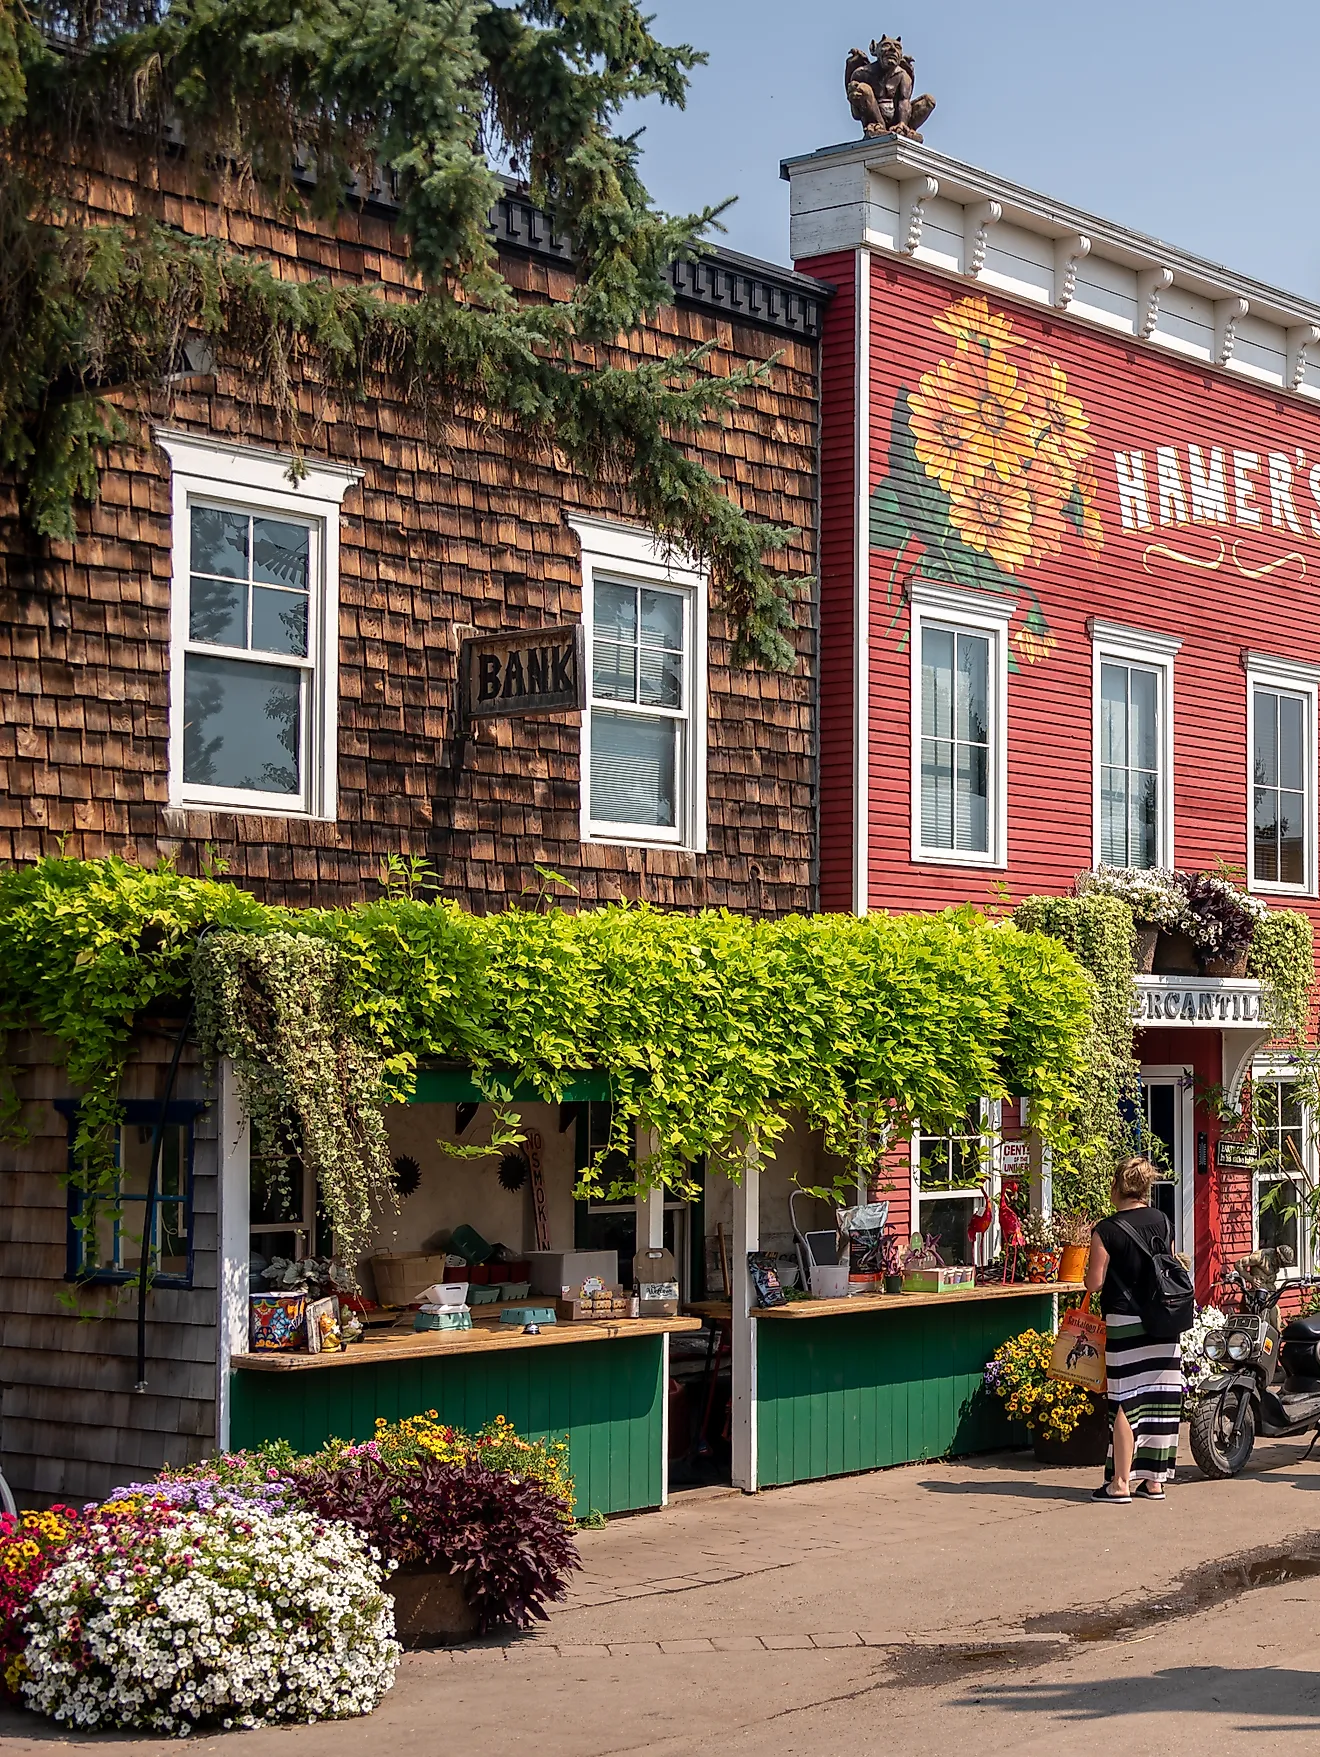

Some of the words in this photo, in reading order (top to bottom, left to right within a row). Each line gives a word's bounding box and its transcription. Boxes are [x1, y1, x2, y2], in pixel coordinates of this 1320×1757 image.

[478, 645, 573, 702] BANK
[1130, 991, 1268, 1021] ERCANTIL
[525, 1132, 542, 1150] NO
[531, 1152, 551, 1251] SMOKIN
